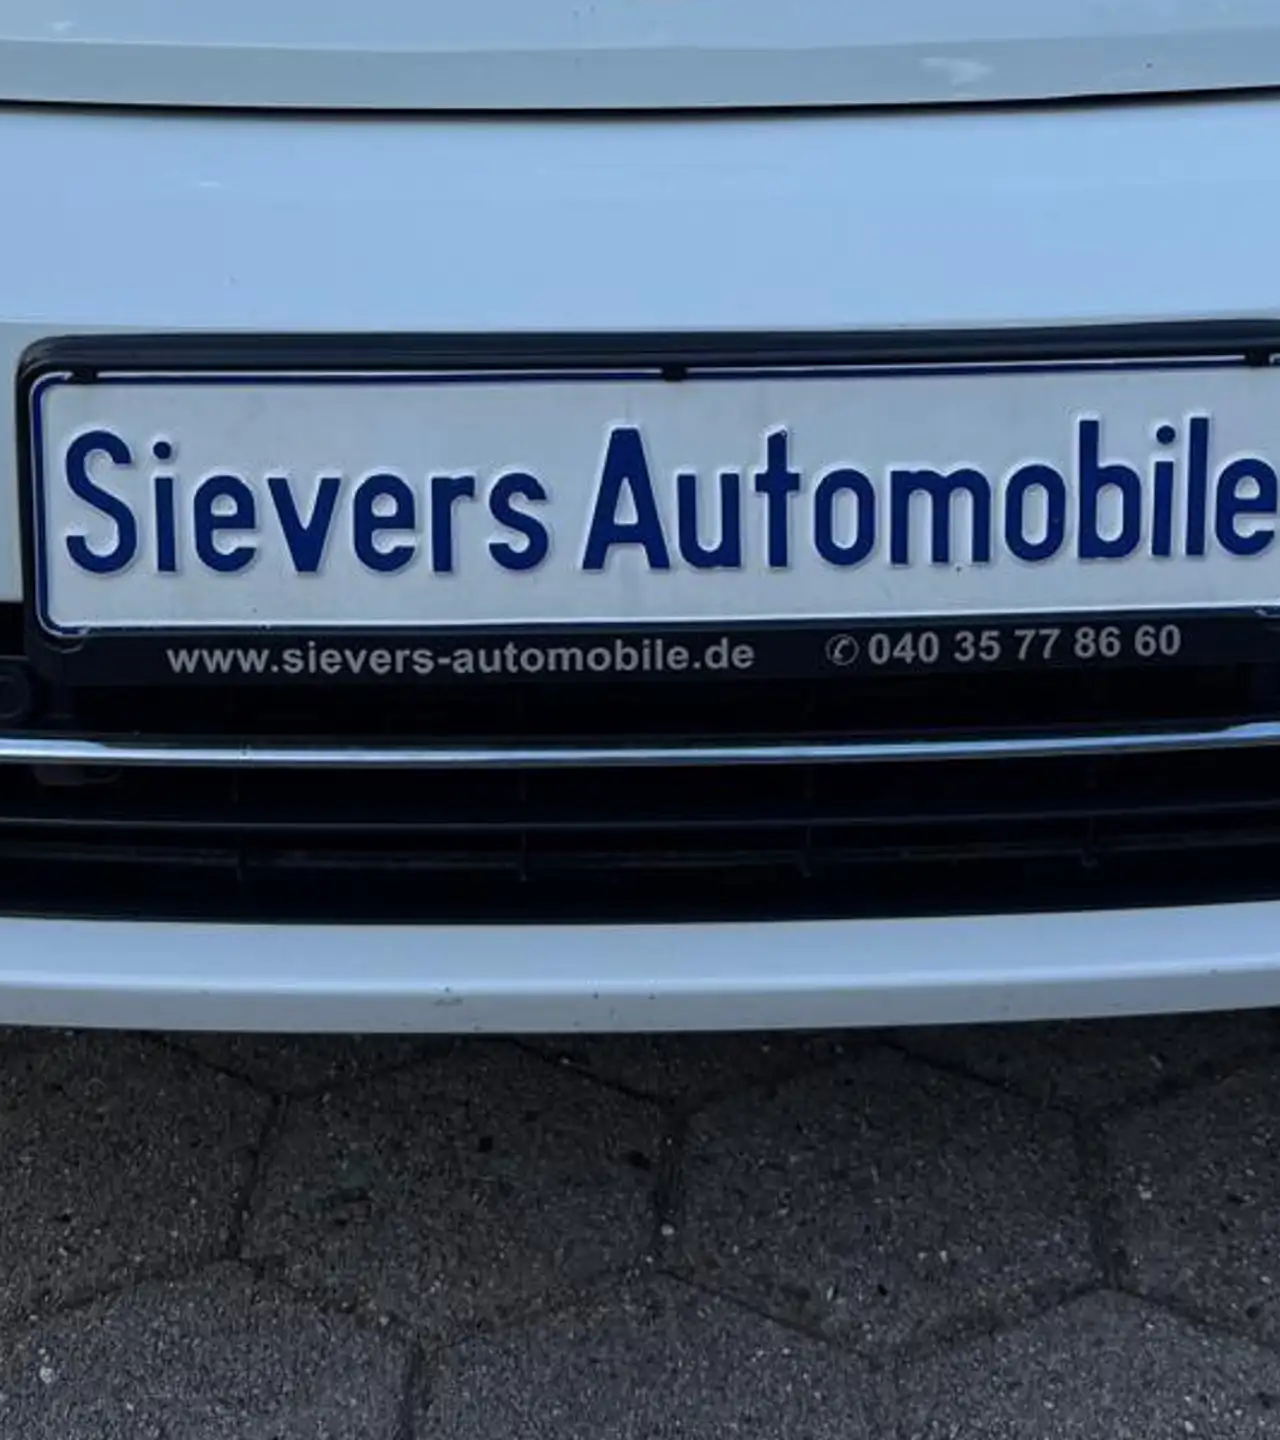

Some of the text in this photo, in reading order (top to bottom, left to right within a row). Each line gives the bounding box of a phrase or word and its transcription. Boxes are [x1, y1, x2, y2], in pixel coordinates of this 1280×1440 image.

[65, 416, 1279, 574] Sievers Automobile
[167, 638, 756, 674] www.sievers-automobile.de
[868, 625, 1182, 664] 040 35 77 86 60
